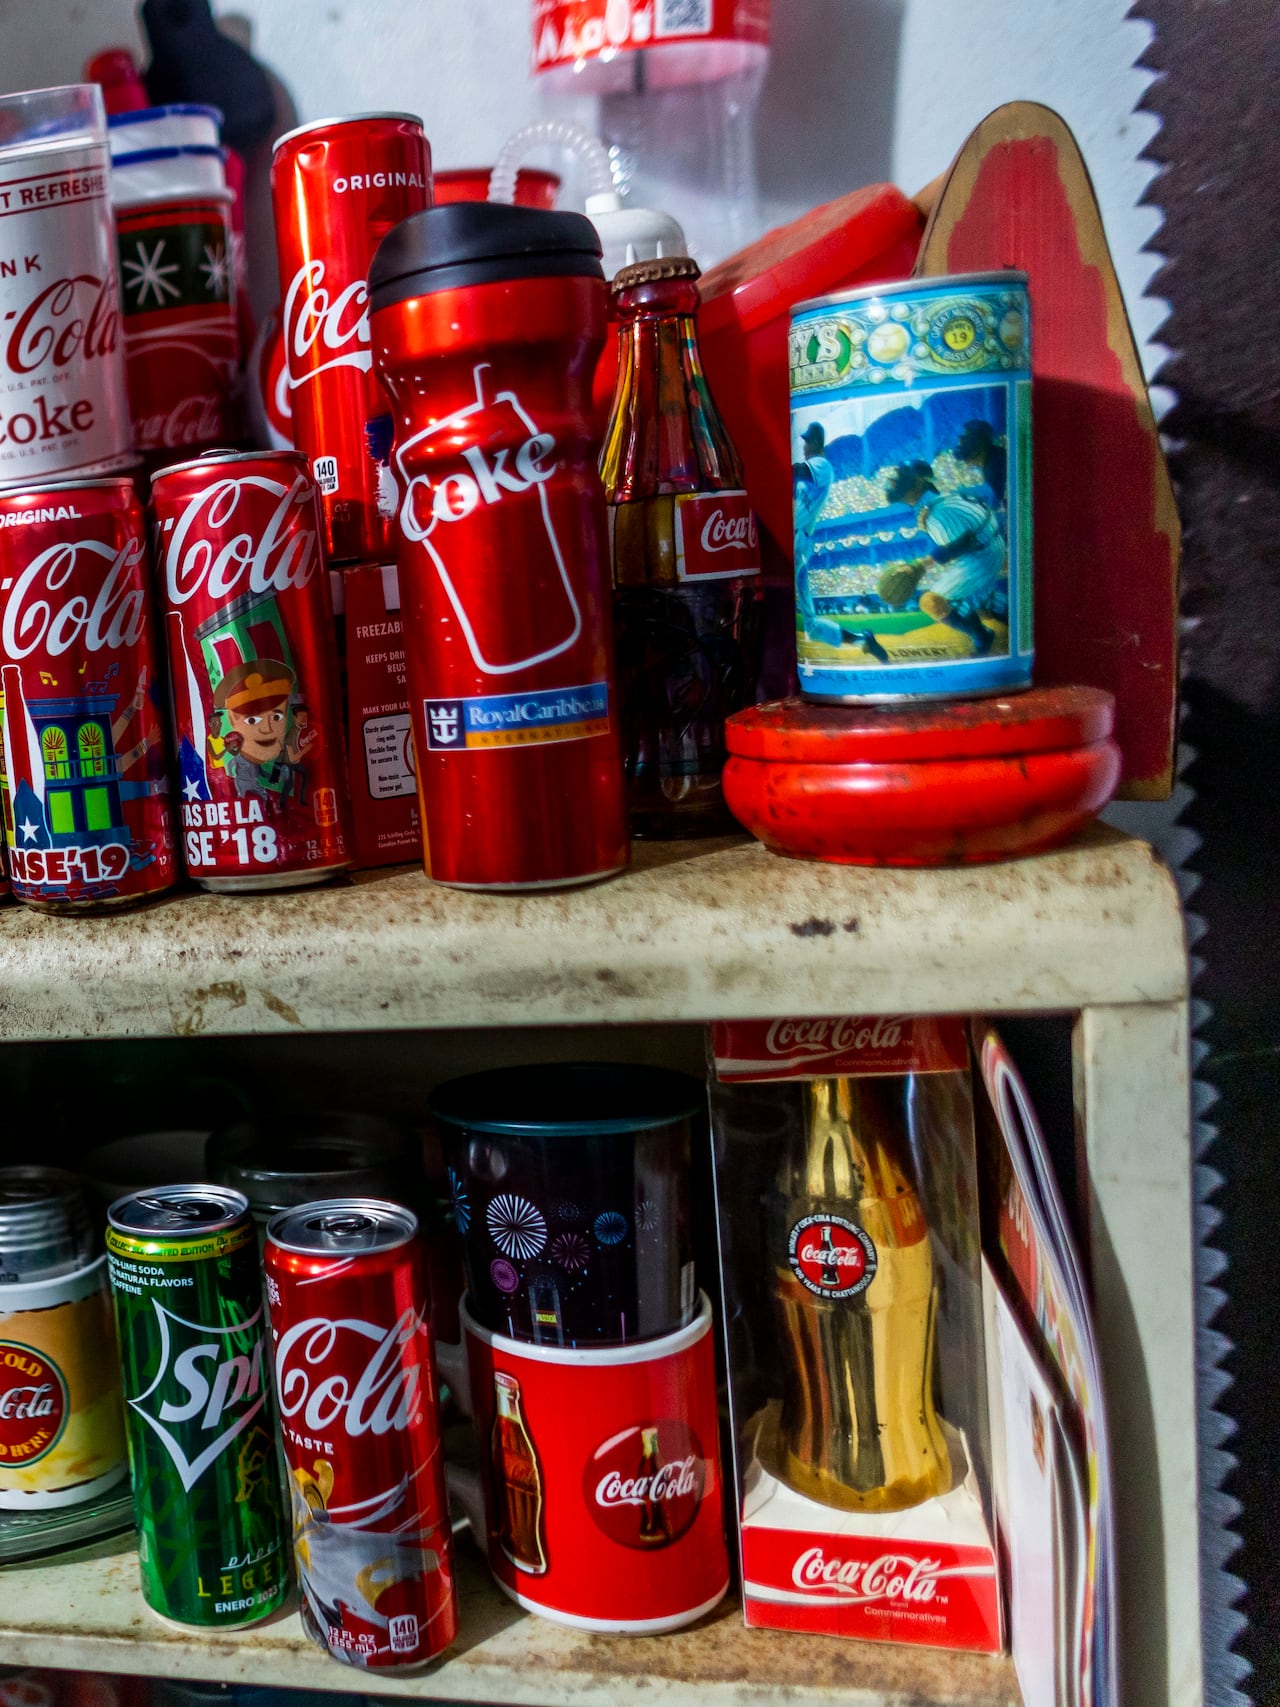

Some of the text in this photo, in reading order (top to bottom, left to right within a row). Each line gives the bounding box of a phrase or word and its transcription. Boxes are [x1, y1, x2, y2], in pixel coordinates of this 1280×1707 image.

[333, 172, 425, 194] ORIGINAL
[317, 460, 335, 478] 140
[365, 652, 388, 665] KEEPS
[387, 662, 407, 673] REUS
[362, 705, 380, 715] MAKE
[381, 702, 398, 712] YOUR
[205, 801, 231, 827] DE
[234, 799, 264, 825] LA
[766, 1017, 903, 1055] Coca-Cola
[830, 1215, 861, 1235] BOTTLING
[857, 1232, 876, 1261] COMPANY
[181, 1243, 215, 1256] EDITION
[801, 1244, 859, 1267] Coca-Cola
[116, 1270, 194, 1288] NATURAL FLAVORS
[138, 1264, 165, 1277] SODA
[803, 1278, 822, 1294] YEARS
[10, 1426, 53, 1457] HERE
[289, 1429, 334, 1456] TASTE
[595, 1455, 696, 1508] Coca-Cola
[791, 1547, 949, 1605] Coca-Cola TM
[215, 1596, 255, 1614] ENERO
[864, 1605, 947, 1624] Commemoratives
[393, 1618, 416, 1635] 140
[329, 1635, 378, 1655] (355 mL)
[342, 1631, 355, 1642] FL
[358, 1634, 376, 1643] OZ
